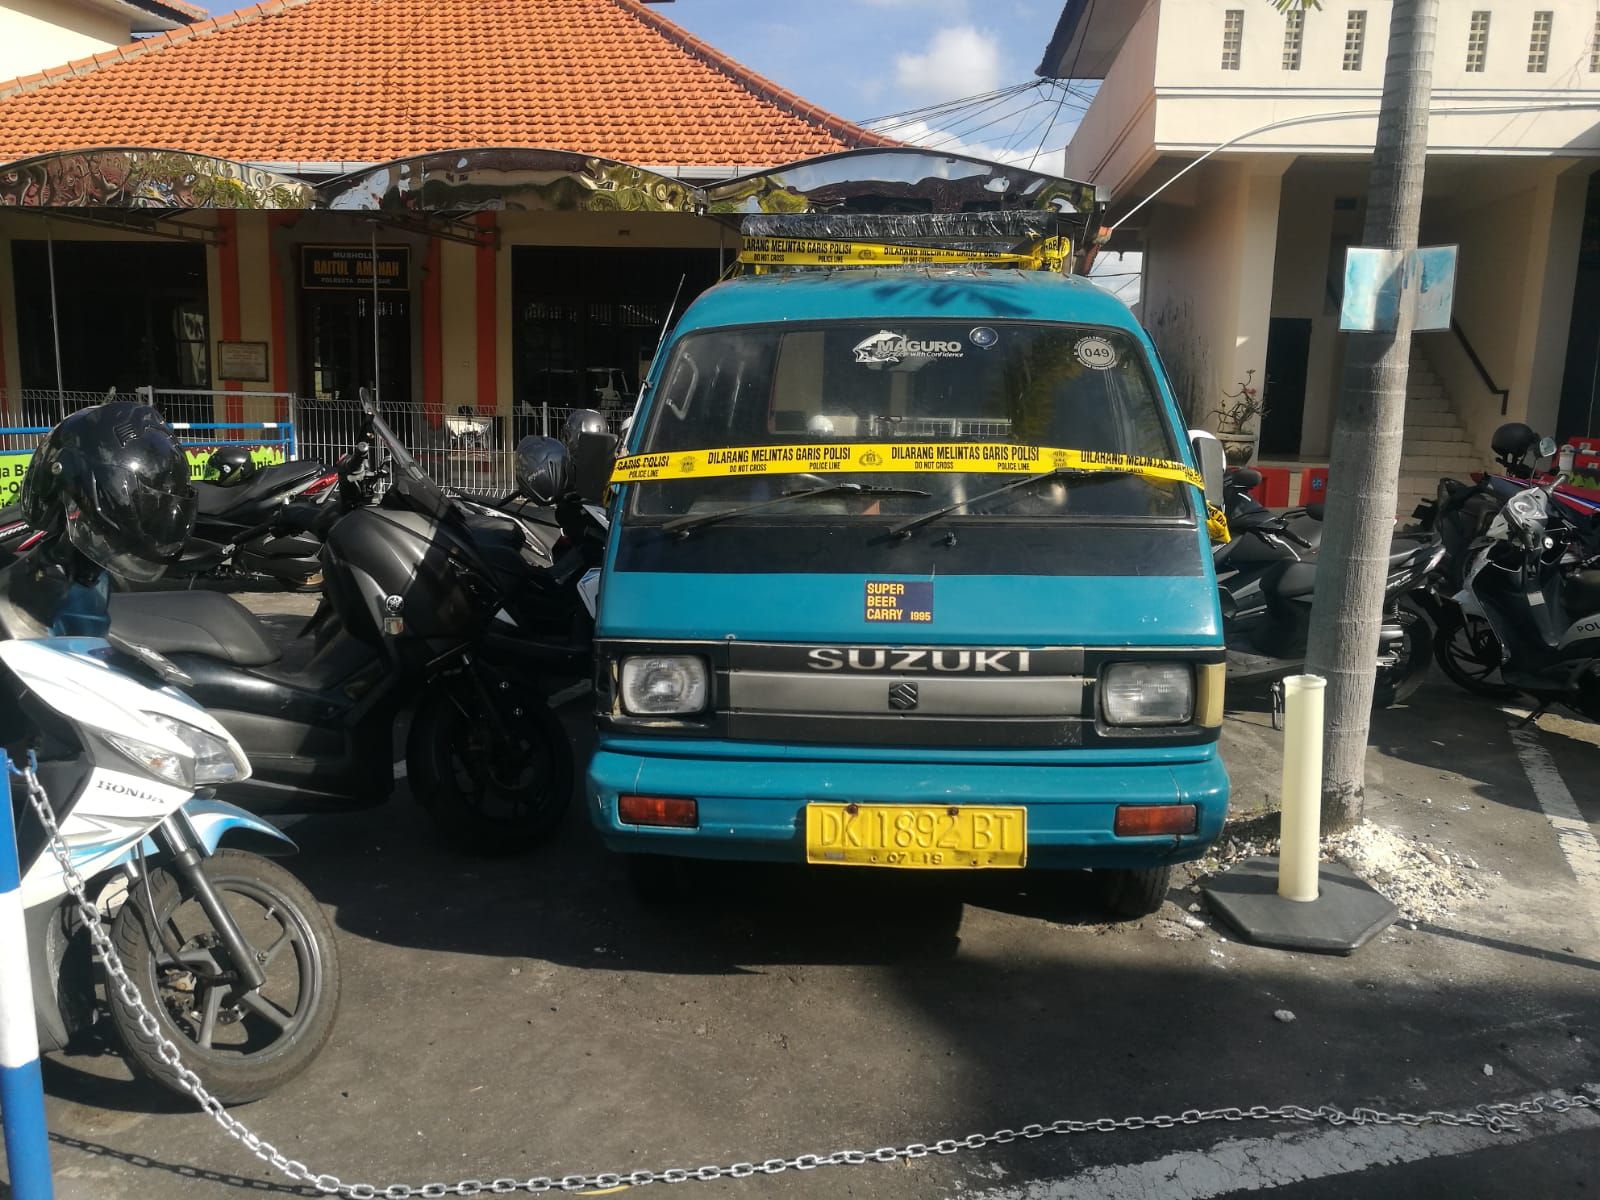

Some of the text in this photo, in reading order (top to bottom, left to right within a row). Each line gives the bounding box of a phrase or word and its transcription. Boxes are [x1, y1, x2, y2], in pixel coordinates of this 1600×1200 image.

[771, 239, 805, 253] MELINTAS
[807, 242, 828, 254] GARIS
[830, 243, 851, 254] POLISI
[770, 254, 785, 262] CROSS
[818, 255, 844, 263] POLICE LINE
[313, 260, 349, 275] BAITUL
[877, 340, 962, 352] MAGURO
[1084, 347, 1110, 357] 049
[707, 447, 851, 465] DILARANG MELINTAS GARIS POLISI
[891, 446, 1040, 461] DILARANG MELINTAS GARIS POLISI
[1080, 450, 1124, 466] DILARANG
[617, 455, 670, 472] GARIS POLISI
[729, 463, 767, 473] DO NOT CROSS
[809, 461, 841, 470] POLICE LINE
[914, 461, 923, 469] DO
[923, 462, 935, 470] NOT
[997, 463, 1030, 471] POLICE LINE
[628, 469, 660, 479] POLICE LINE
[867, 583, 904, 595] SUPER
[867, 595, 897, 607] BEER
[866, 608, 932, 621] CARRY 1995
[807, 648, 1031, 672] SUZUKI
[96, 780, 165, 804] HONDA
[820, 808, 1015, 850] DK 1892 BT
